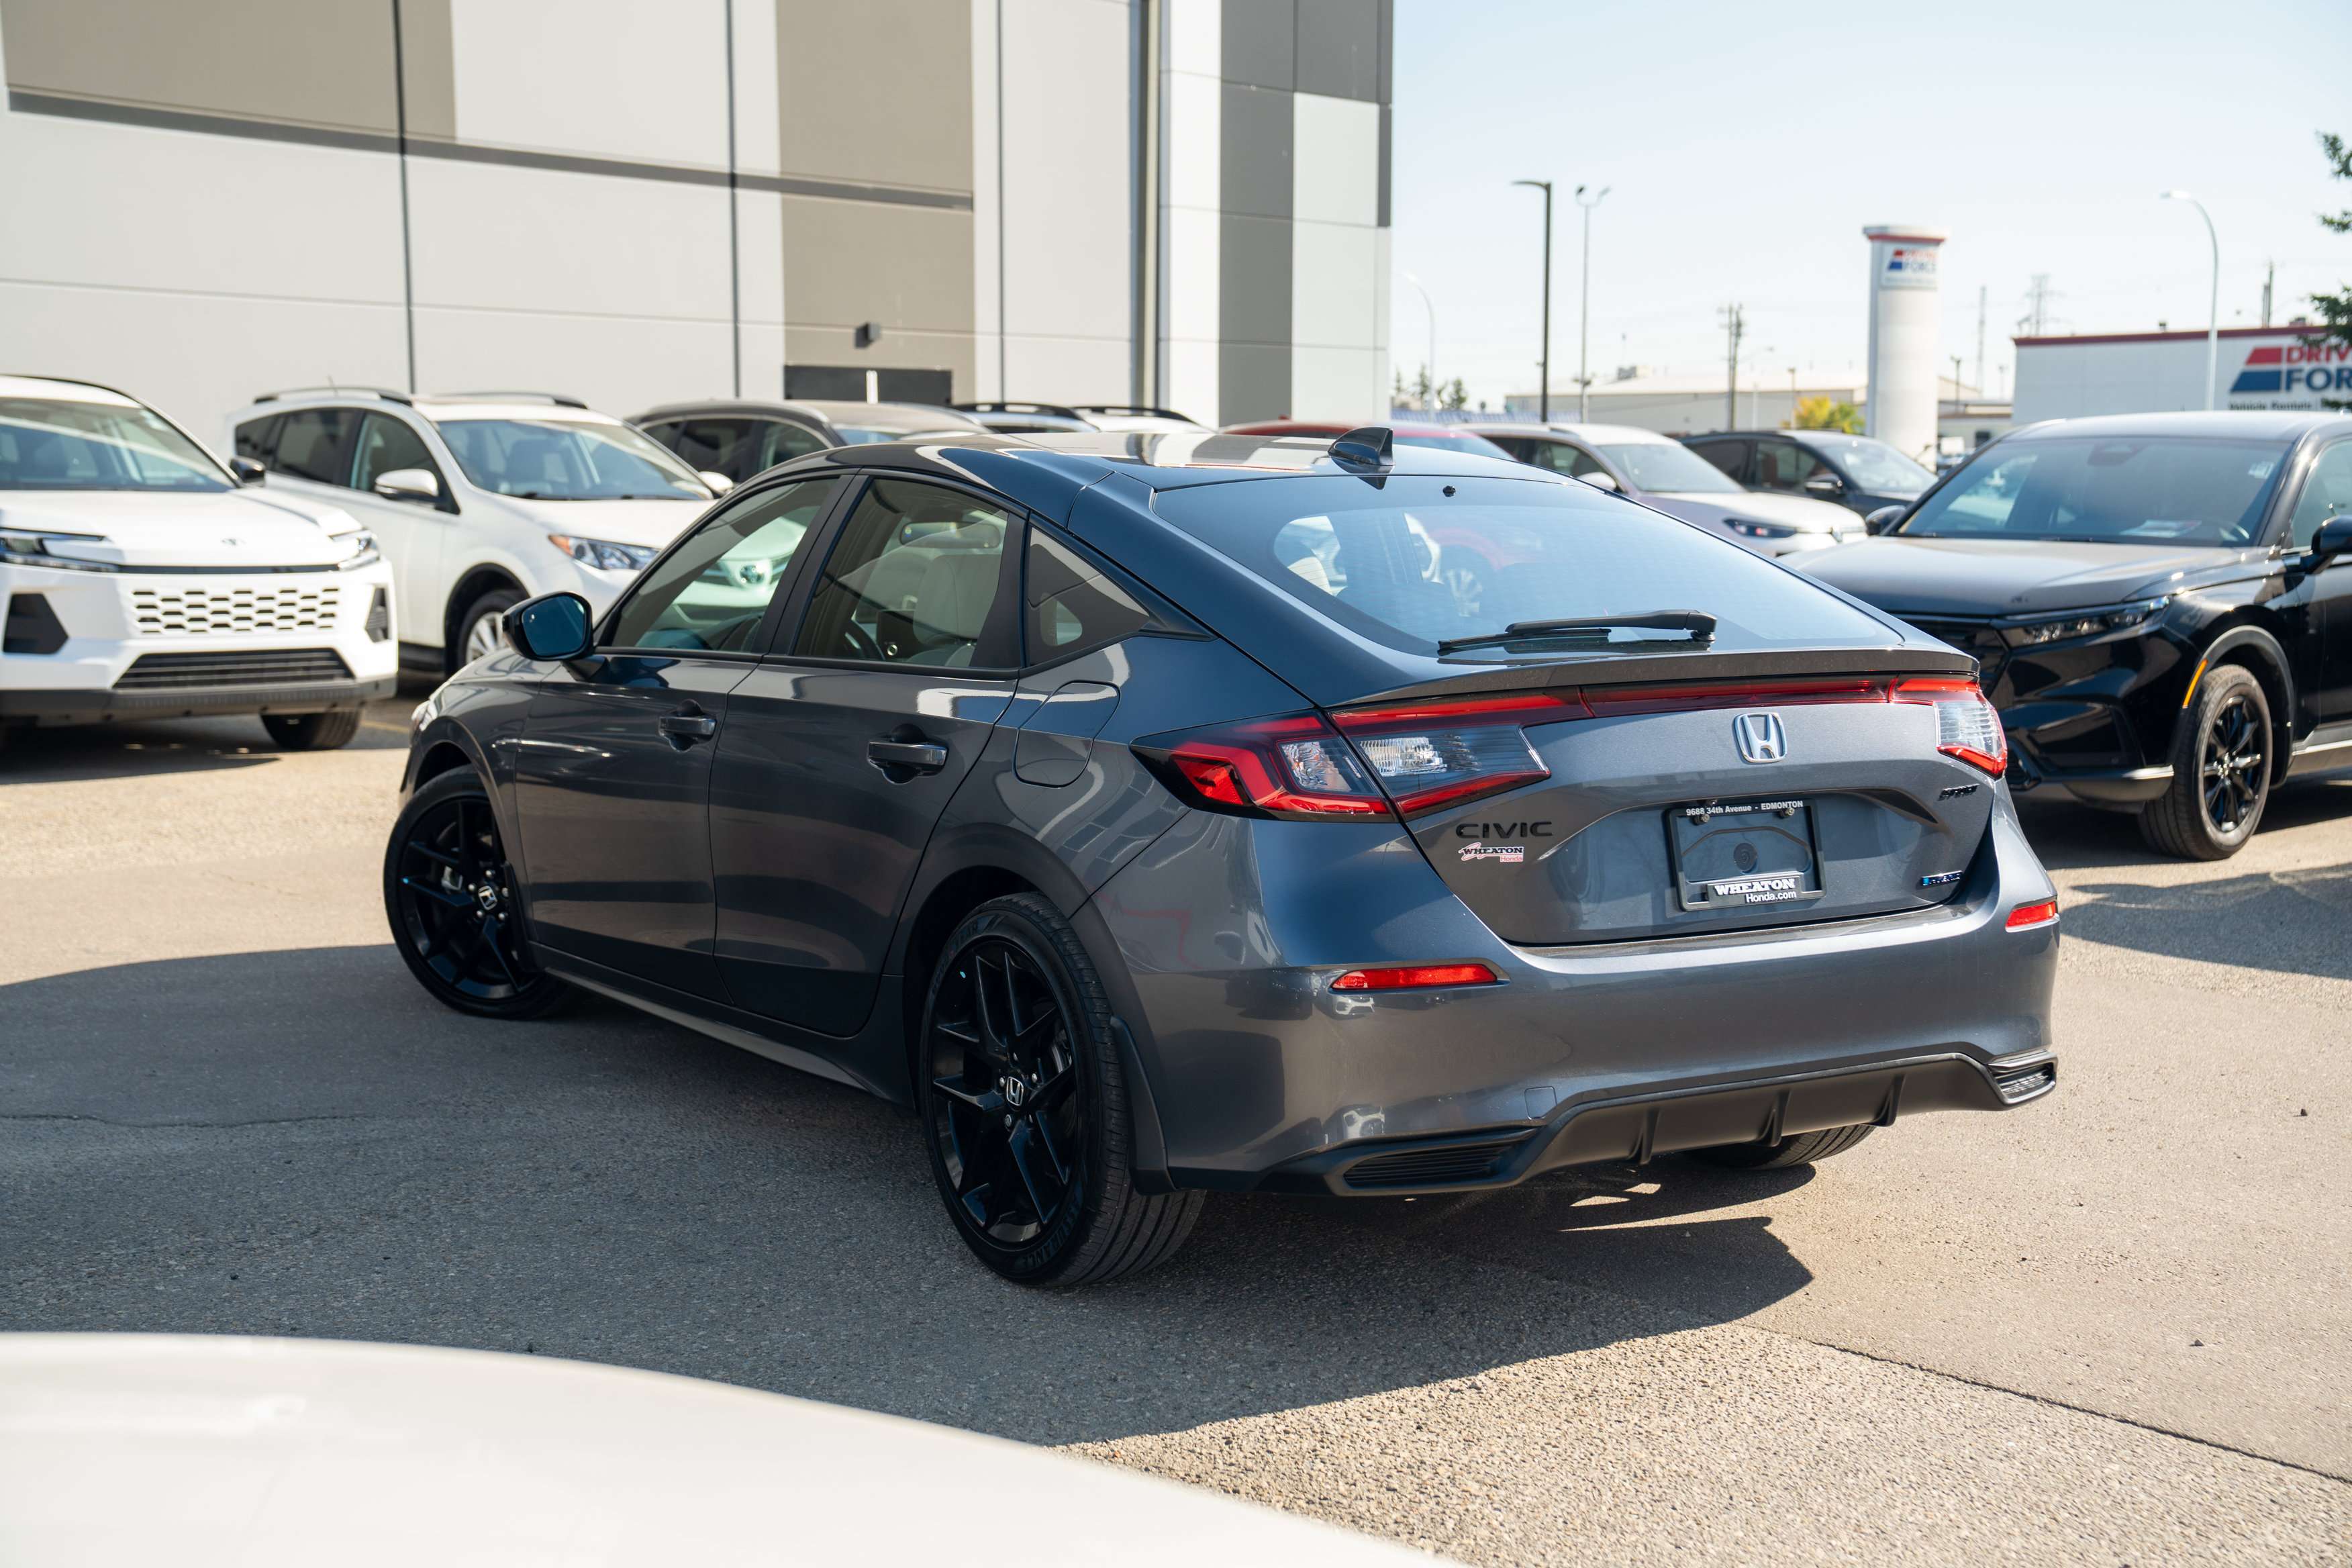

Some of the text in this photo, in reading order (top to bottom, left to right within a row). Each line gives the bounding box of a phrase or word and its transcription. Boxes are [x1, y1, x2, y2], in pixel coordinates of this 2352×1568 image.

[1686, 807, 1705, 816] 9688
[1706, 805, 1724, 815] 34th
[1724, 805, 1752, 814] Avenue
[1761, 800, 1804, 810] EDMONTON
[1456, 821, 1554, 839] CIVIC
[1714, 878, 1796, 895] WHEATON
[1745, 891, 1797, 903] Honda.com
